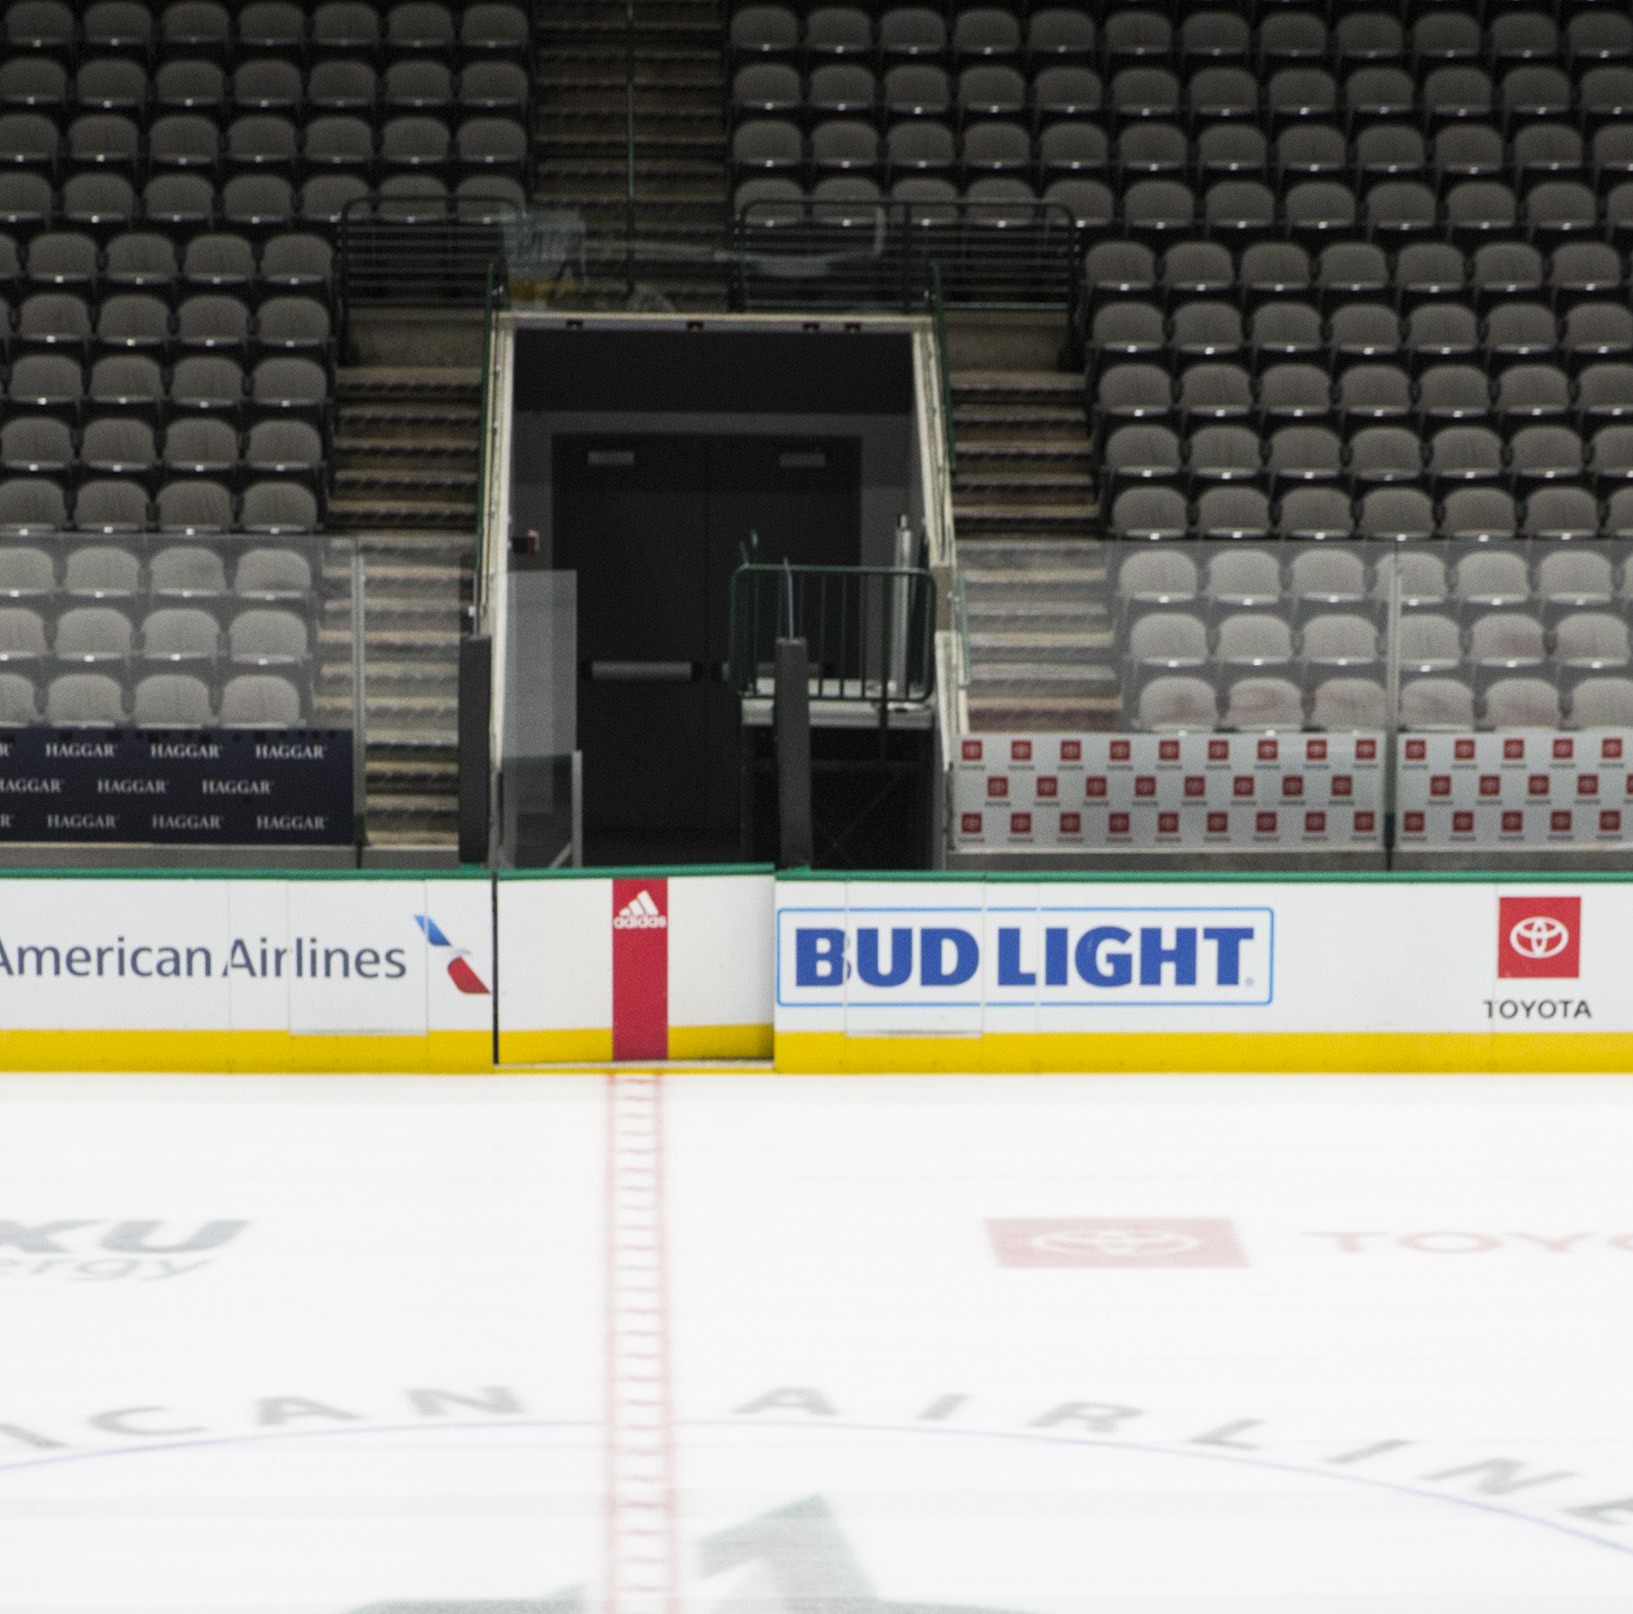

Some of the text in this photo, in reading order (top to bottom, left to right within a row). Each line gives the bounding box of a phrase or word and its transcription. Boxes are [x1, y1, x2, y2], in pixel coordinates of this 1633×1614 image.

[44, 742, 118, 758] HAGGAR
[149, 744, 223, 759] HAGGAR
[254, 744, 328, 760] HAGGAR
[96, 779, 169, 794] HAGGAR
[200, 779, 275, 795] HAGGAR
[46, 814, 118, 828] HAGGAR
[151, 814, 223, 829] HAGGAR
[255, 815, 329, 830] HAGGAR
[613, 914, 667, 929] adidas
[224, 936, 407, 979] Airlines
[795, 926, 1254, 988] BUD LIGHT
[1484, 999, 1592, 1020] TOYOTA
